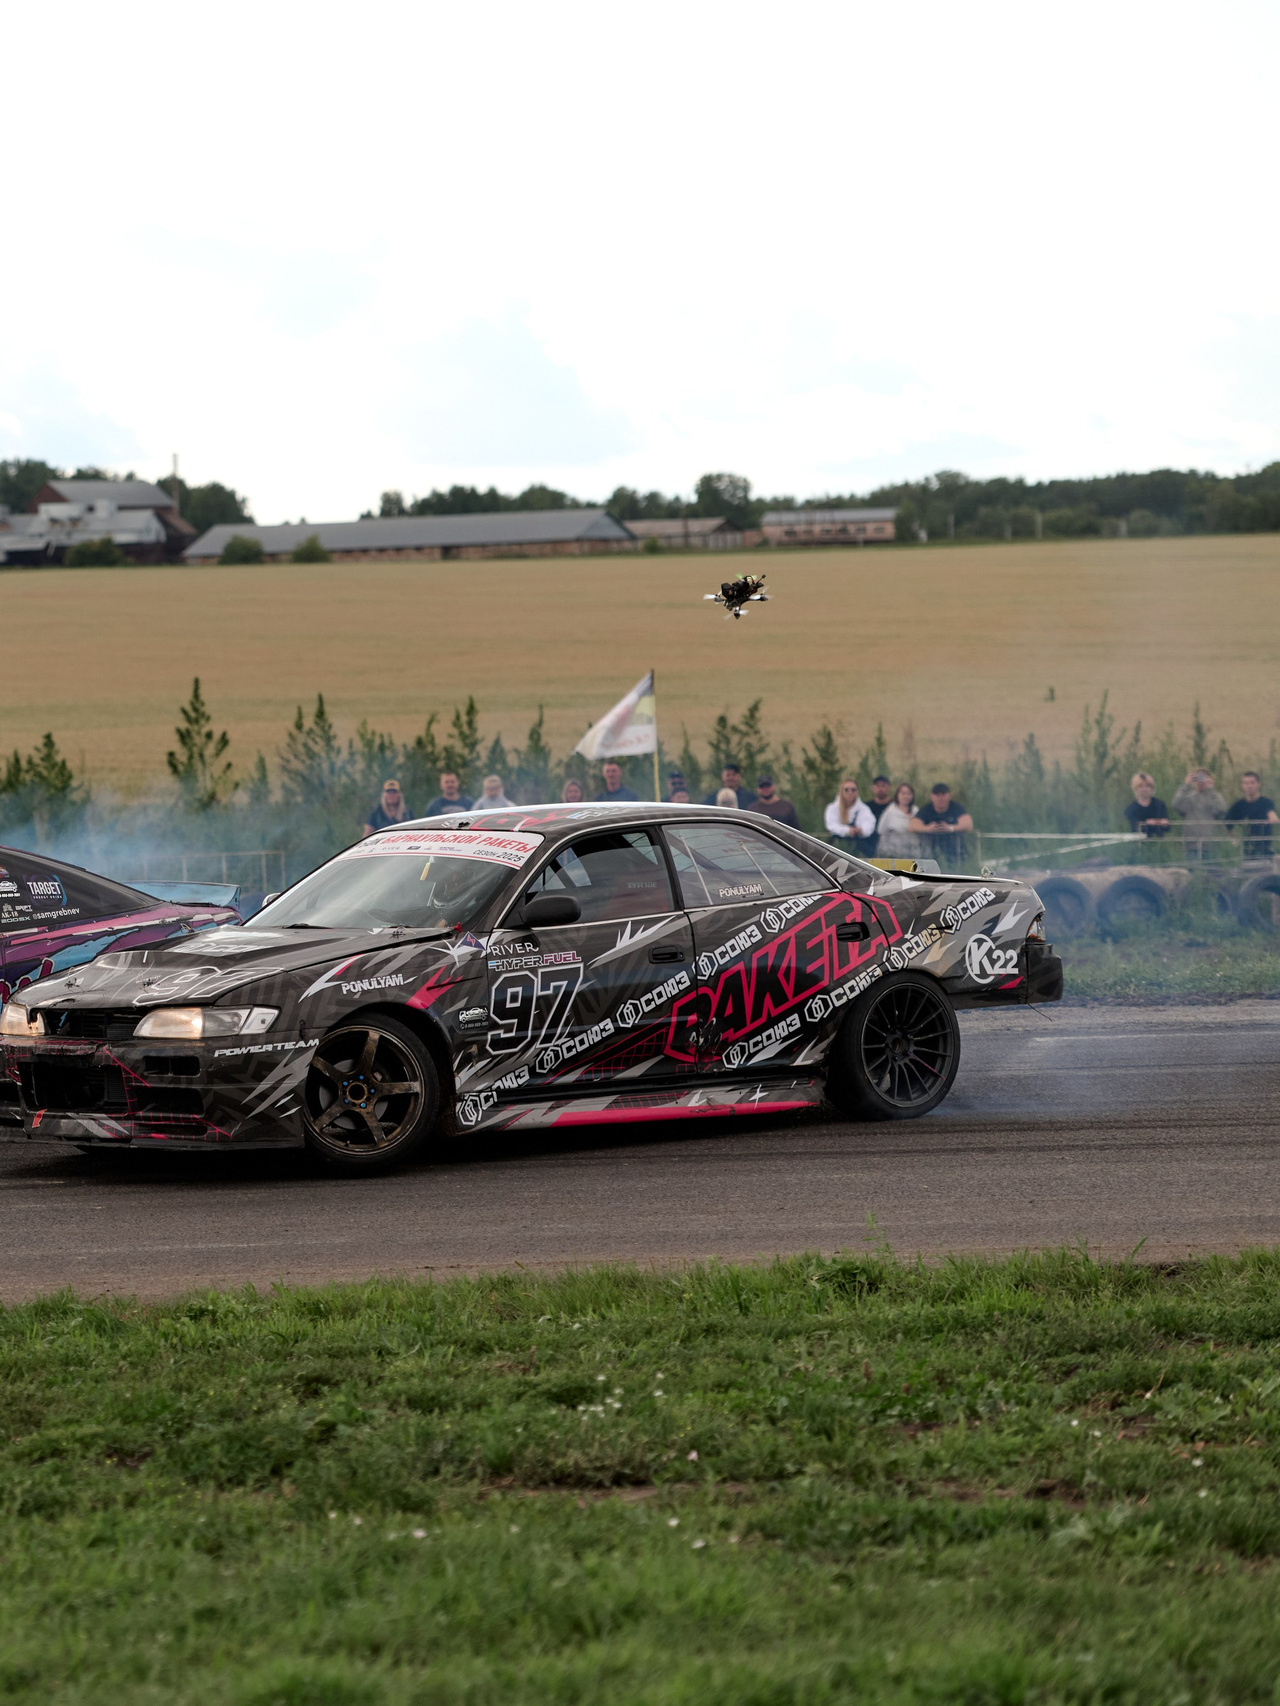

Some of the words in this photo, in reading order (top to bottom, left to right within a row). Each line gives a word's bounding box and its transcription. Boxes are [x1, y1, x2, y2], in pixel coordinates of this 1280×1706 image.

[383, 833, 481, 845] БАРНАУЛЬСКОЙ
[480, 837, 537, 853] РАКЕТЫ
[496, 851, 526, 863] 2025
[27, 882, 62, 895] TARGET
[719, 883, 763, 898] PONULYAM
[491, 942, 540, 957] RIVER
[132, 965, 285, 1006] 97
[341, 974, 404, 995] PONULYAM
[486, 962, 585, 1055] 97
